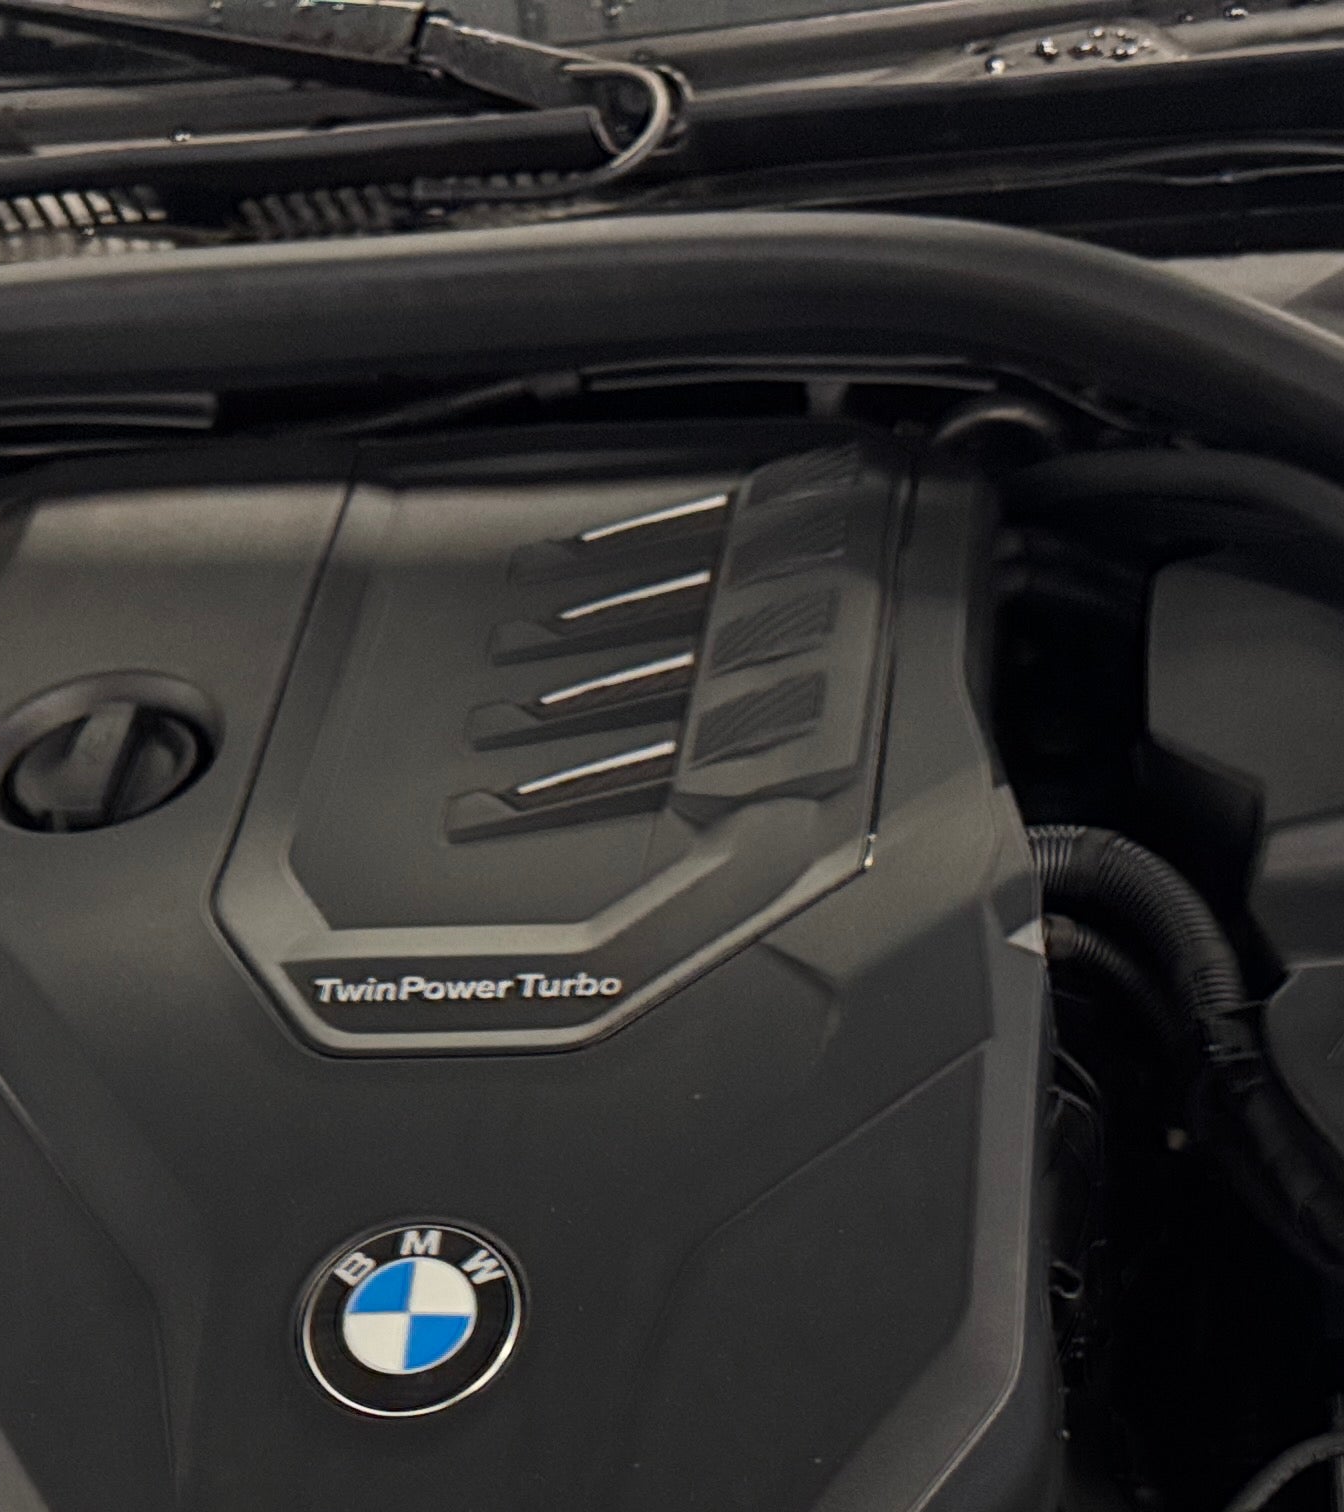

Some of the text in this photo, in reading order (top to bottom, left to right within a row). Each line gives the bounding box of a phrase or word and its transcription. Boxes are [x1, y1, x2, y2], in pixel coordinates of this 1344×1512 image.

[314, 972, 623, 1002] TwinPower Turbo
[333, 1229, 507, 1287] BMW
